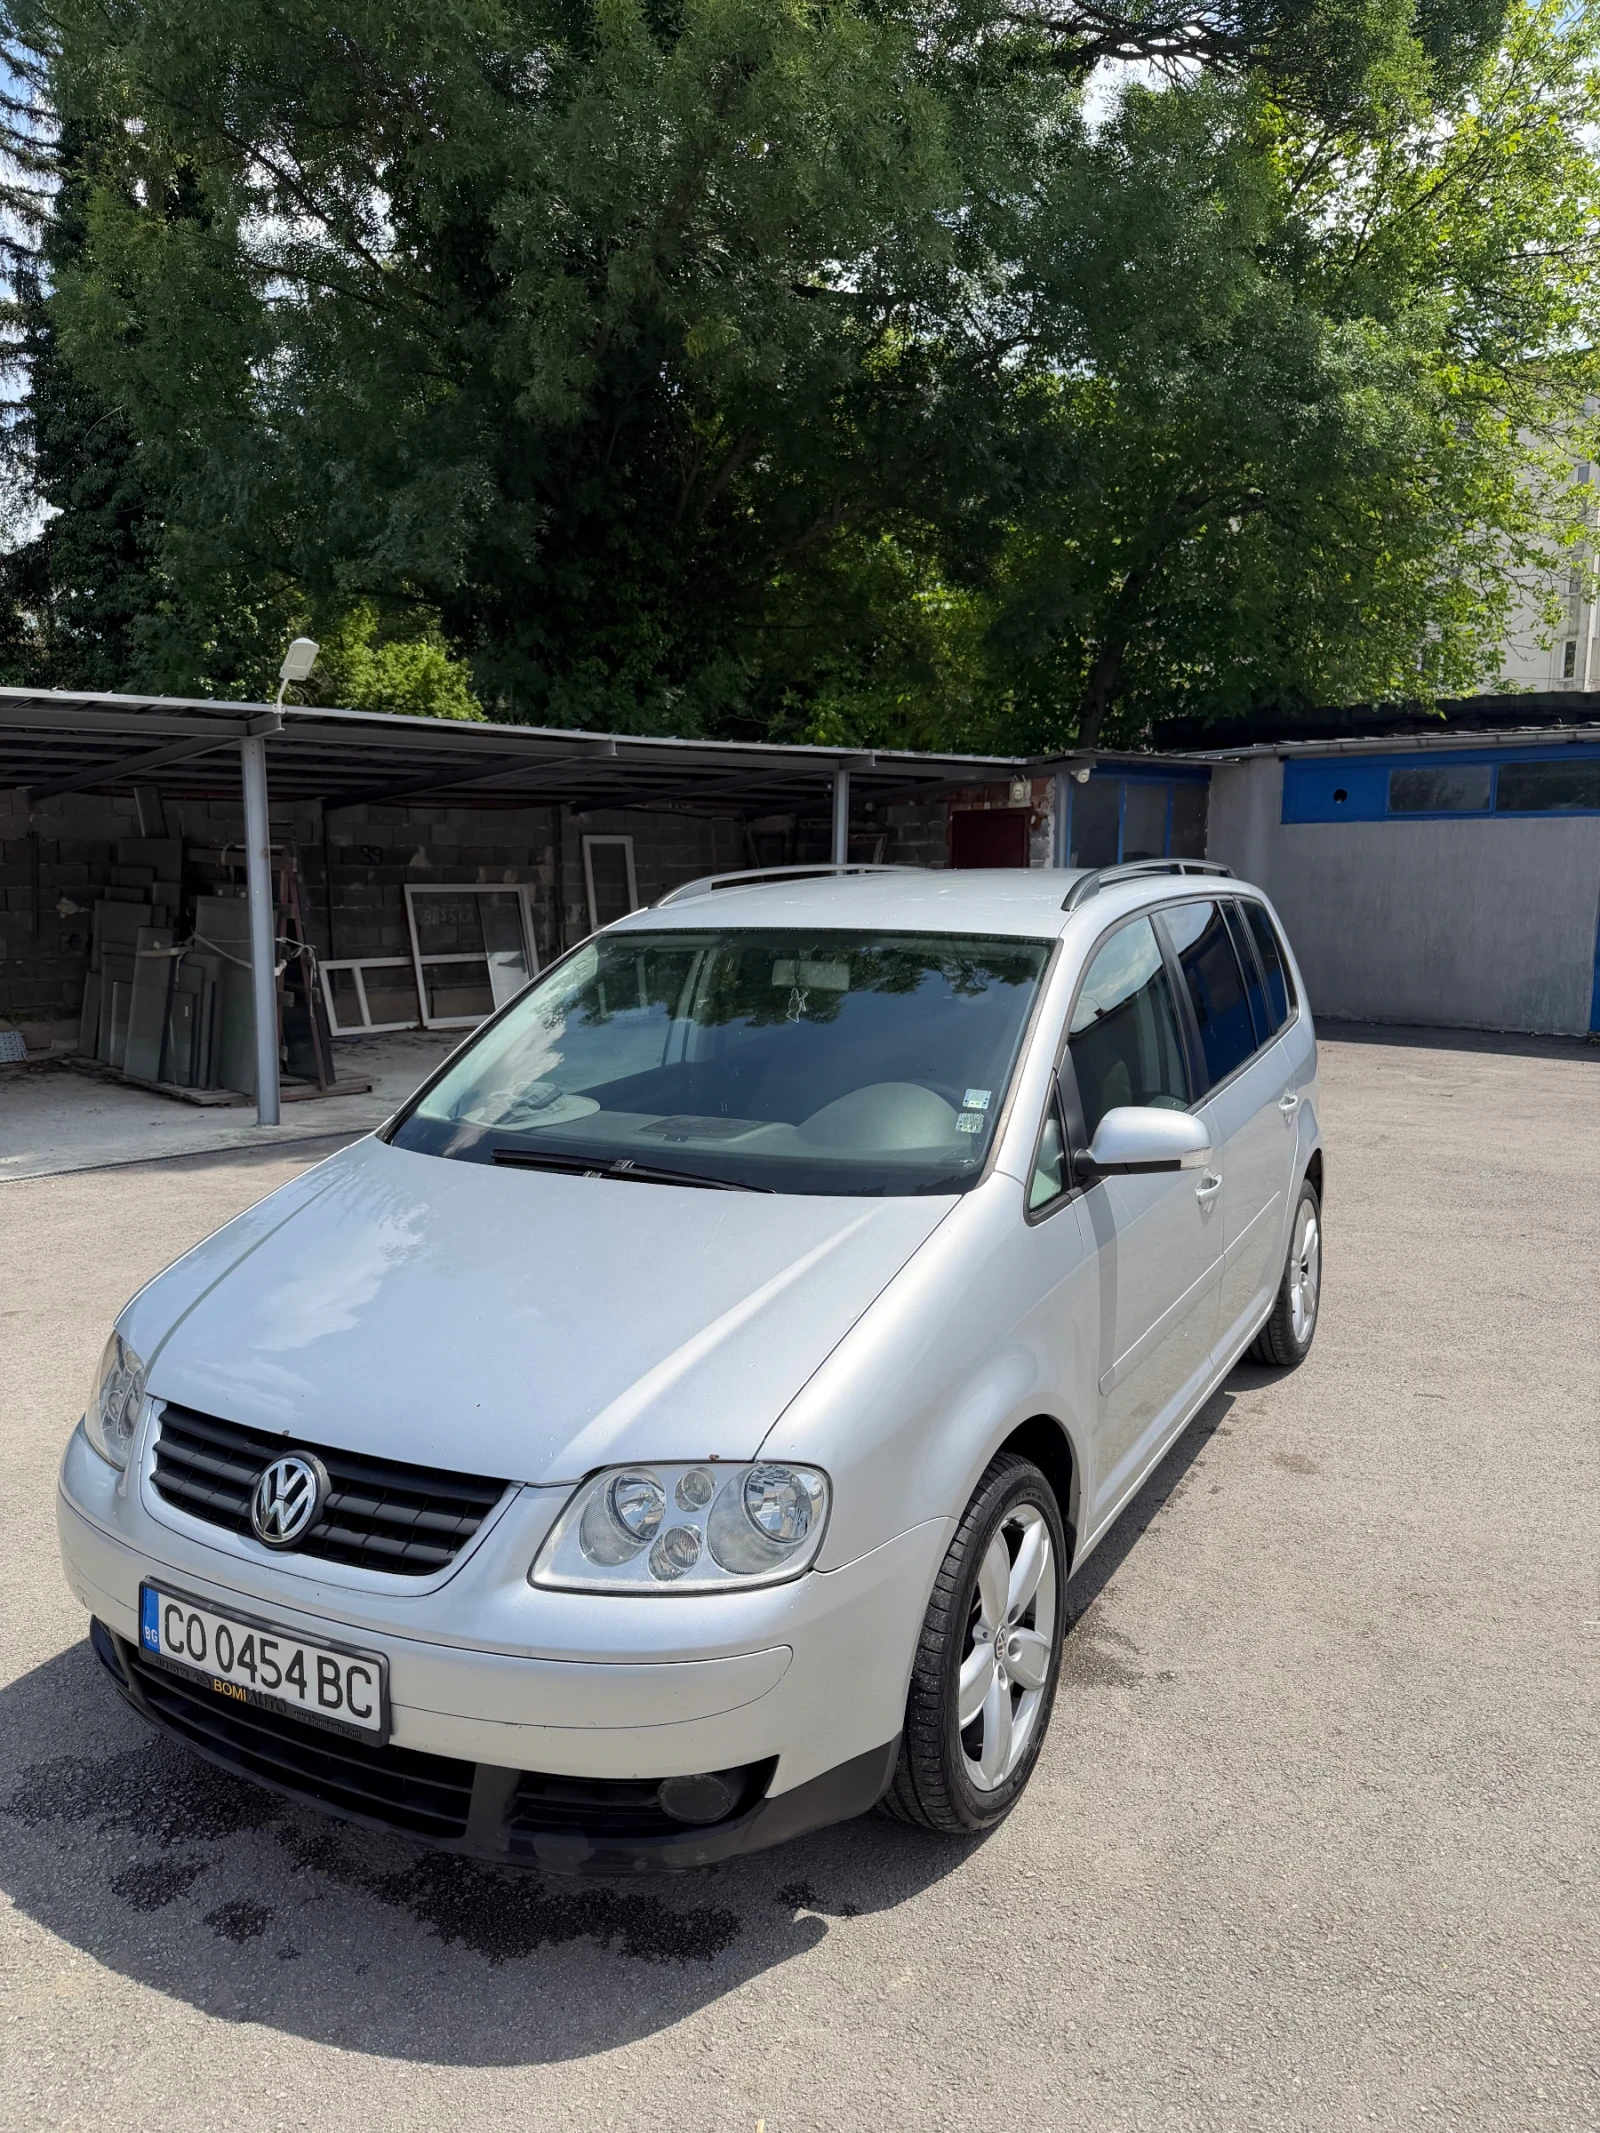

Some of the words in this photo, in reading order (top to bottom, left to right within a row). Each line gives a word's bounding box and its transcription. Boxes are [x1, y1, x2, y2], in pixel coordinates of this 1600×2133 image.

[360, 845, 383, 866] 39
[144, 1625, 158, 1643] BG
[164, 1604, 207, 1661] CO
[215, 1624, 307, 1699] 0454
[317, 1655, 372, 1718] BC
